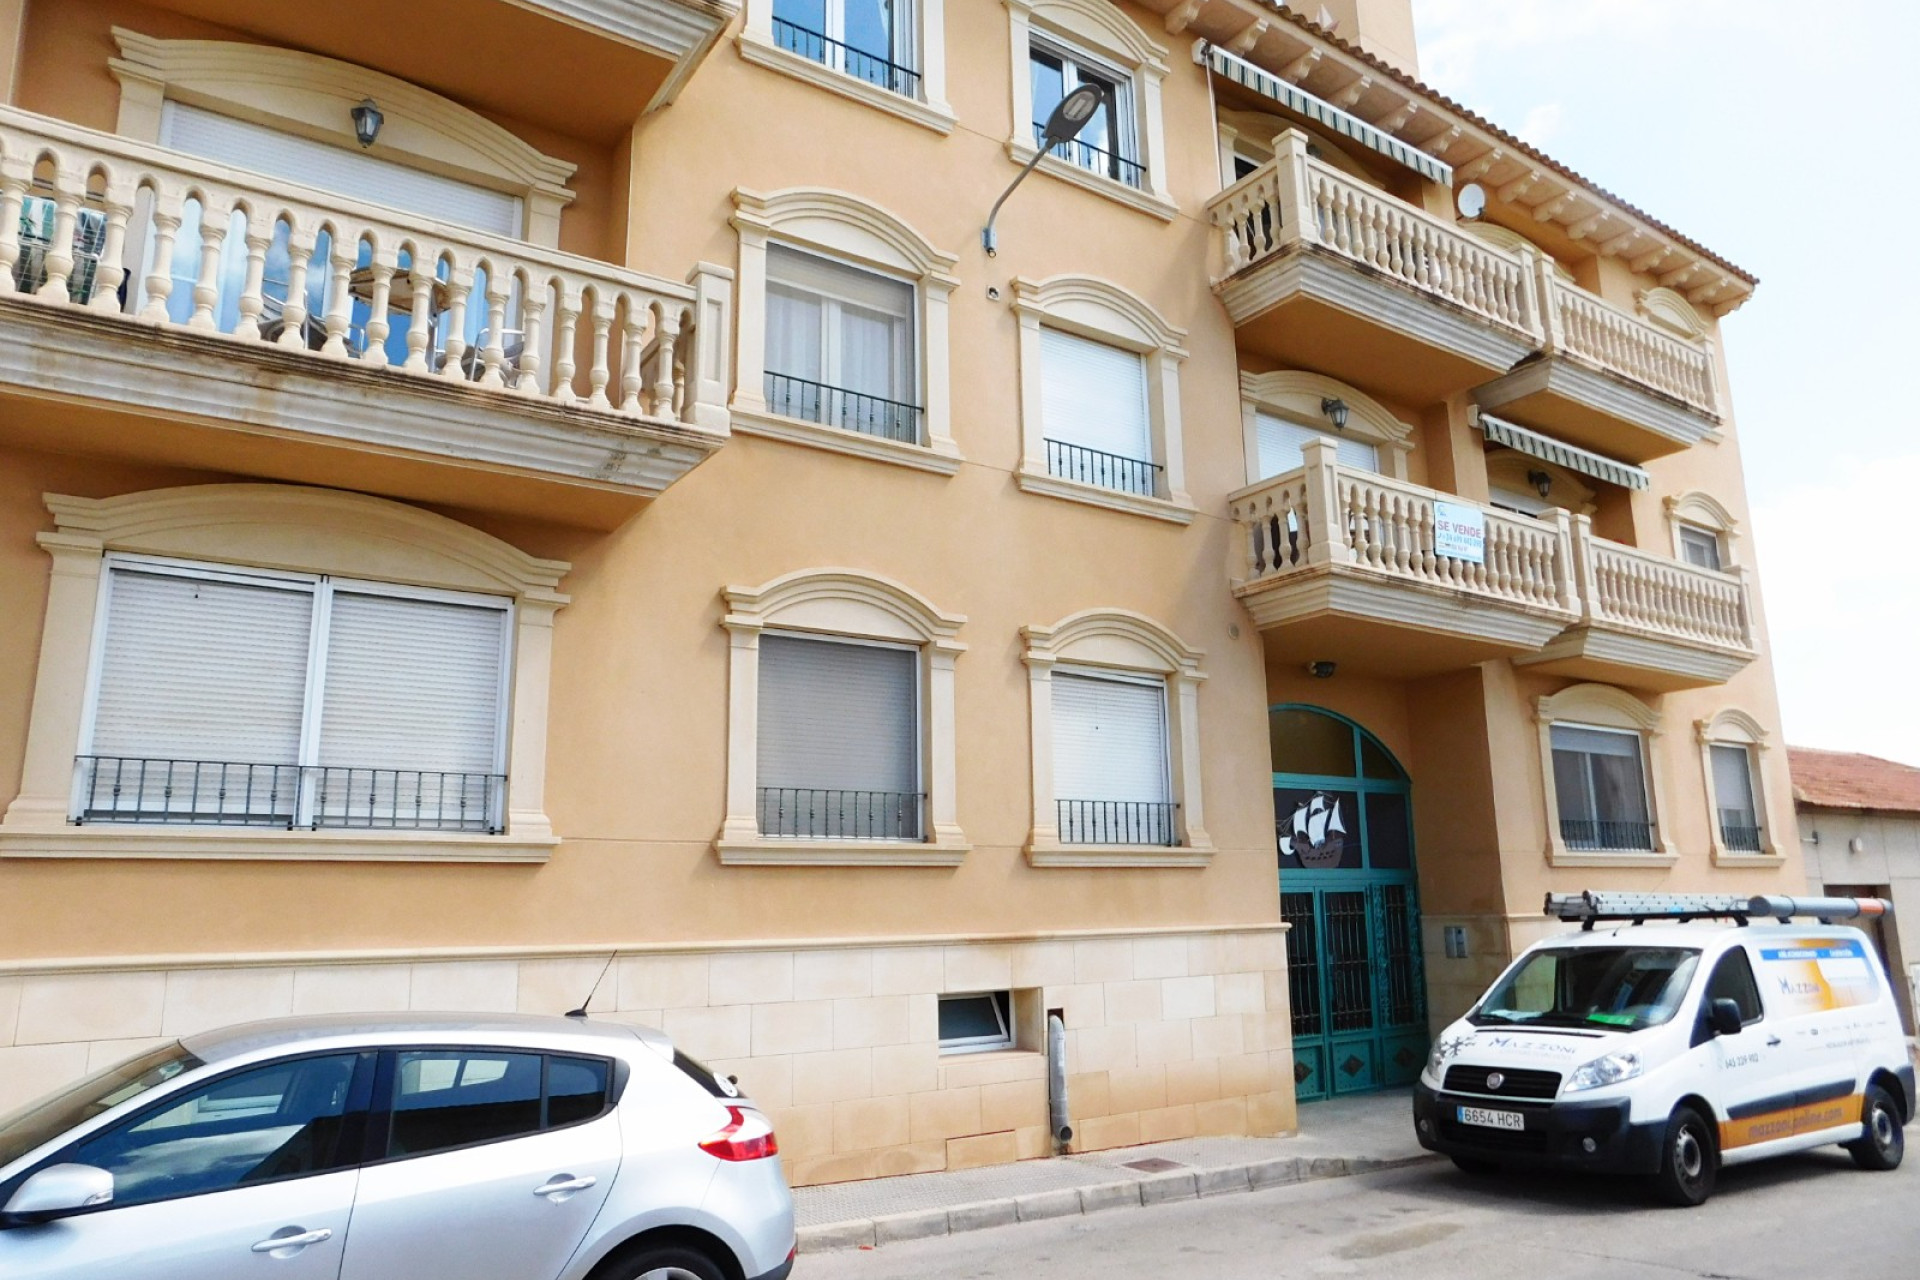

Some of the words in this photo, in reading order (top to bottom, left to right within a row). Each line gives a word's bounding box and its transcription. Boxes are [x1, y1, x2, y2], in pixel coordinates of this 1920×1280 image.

[1437, 520, 1449, 531] SE
[1452, 522, 1481, 539] VENDE
[1464, 1108, 1494, 1124] 6654
[1497, 1112, 1521, 1128] HCR
